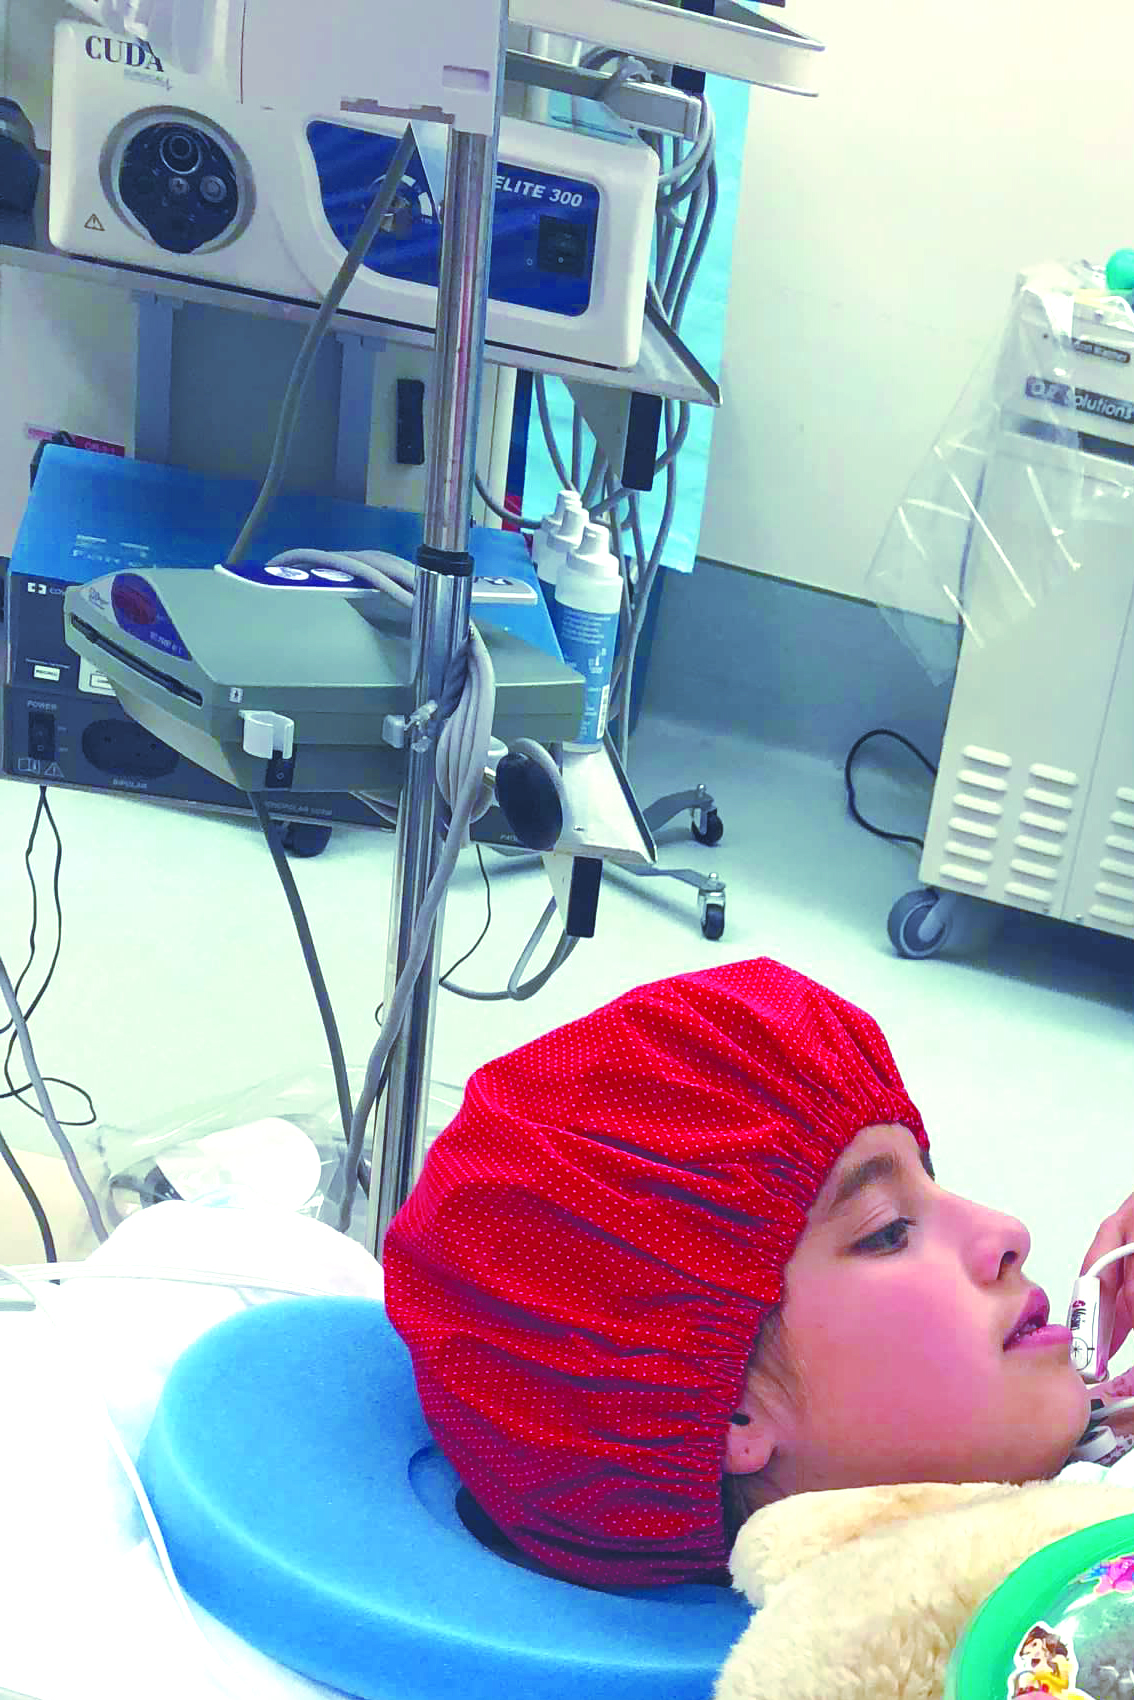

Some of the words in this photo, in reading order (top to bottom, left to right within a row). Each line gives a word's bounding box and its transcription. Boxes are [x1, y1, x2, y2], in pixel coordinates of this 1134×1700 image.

[85, 36, 164, 72] CUDA
[495, 175, 546, 199] ELITE
[549, 188, 583, 208] 300
[27, 700, 57, 711] POWER
